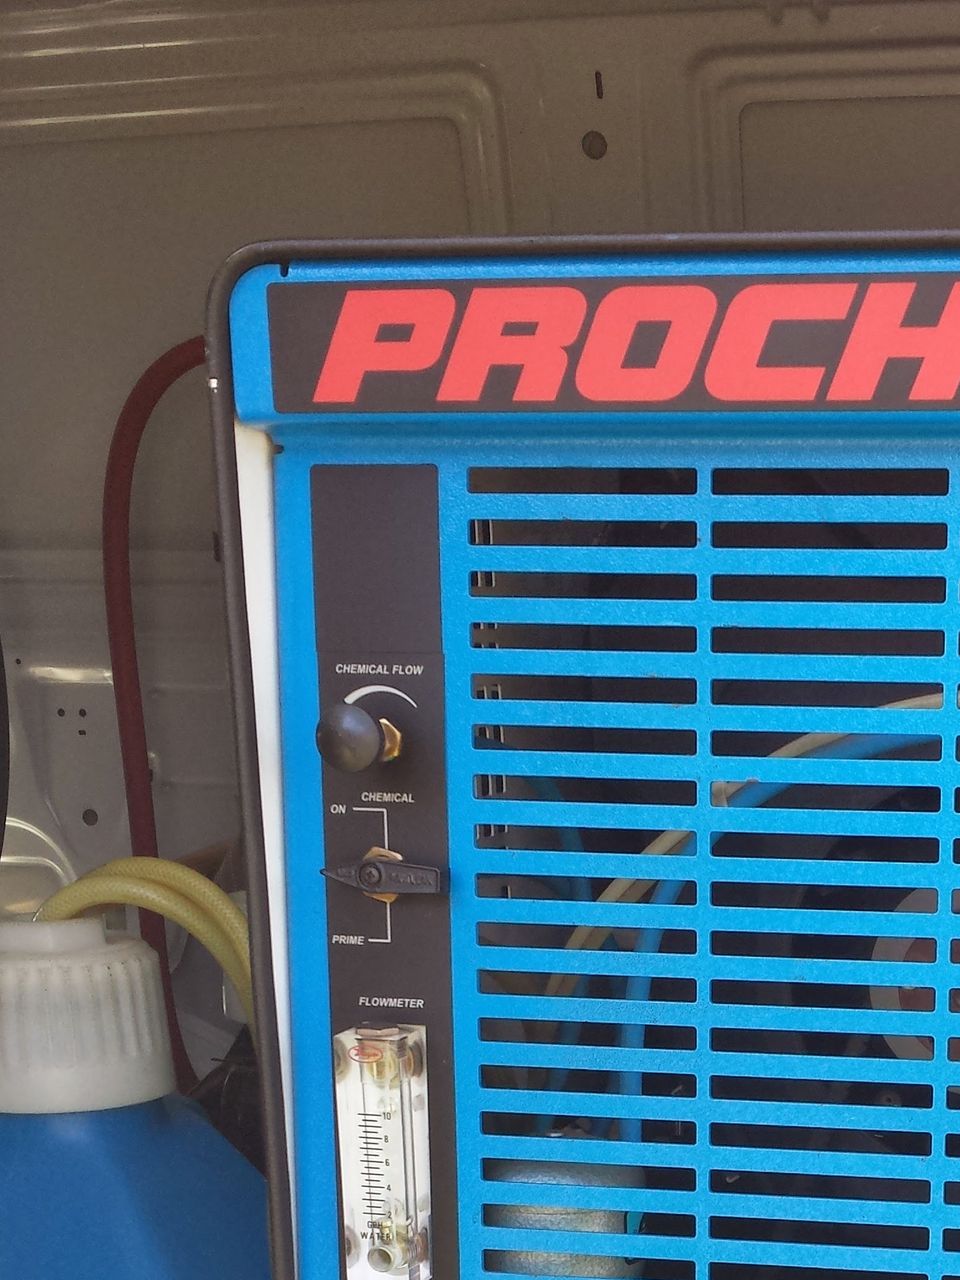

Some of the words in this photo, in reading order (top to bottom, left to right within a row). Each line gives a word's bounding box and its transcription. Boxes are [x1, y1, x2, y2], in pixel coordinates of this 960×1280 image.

[335, 663, 389, 674] CHEMICAL
[391, 664, 423, 675] FLOW
[361, 791, 414, 802] CHEMICAL
[330, 804, 346, 813] ON
[331, 934, 364, 945] PRIME
[358, 996, 424, 1008] FLOWMETER
[382, 1112, 392, 1121] 10
[383, 1135, 389, 1143] 8
[385, 1159, 390, 1167] 6
[386, 1184, 391, 1192] 4
[360, 1231, 391, 1241] WATER
